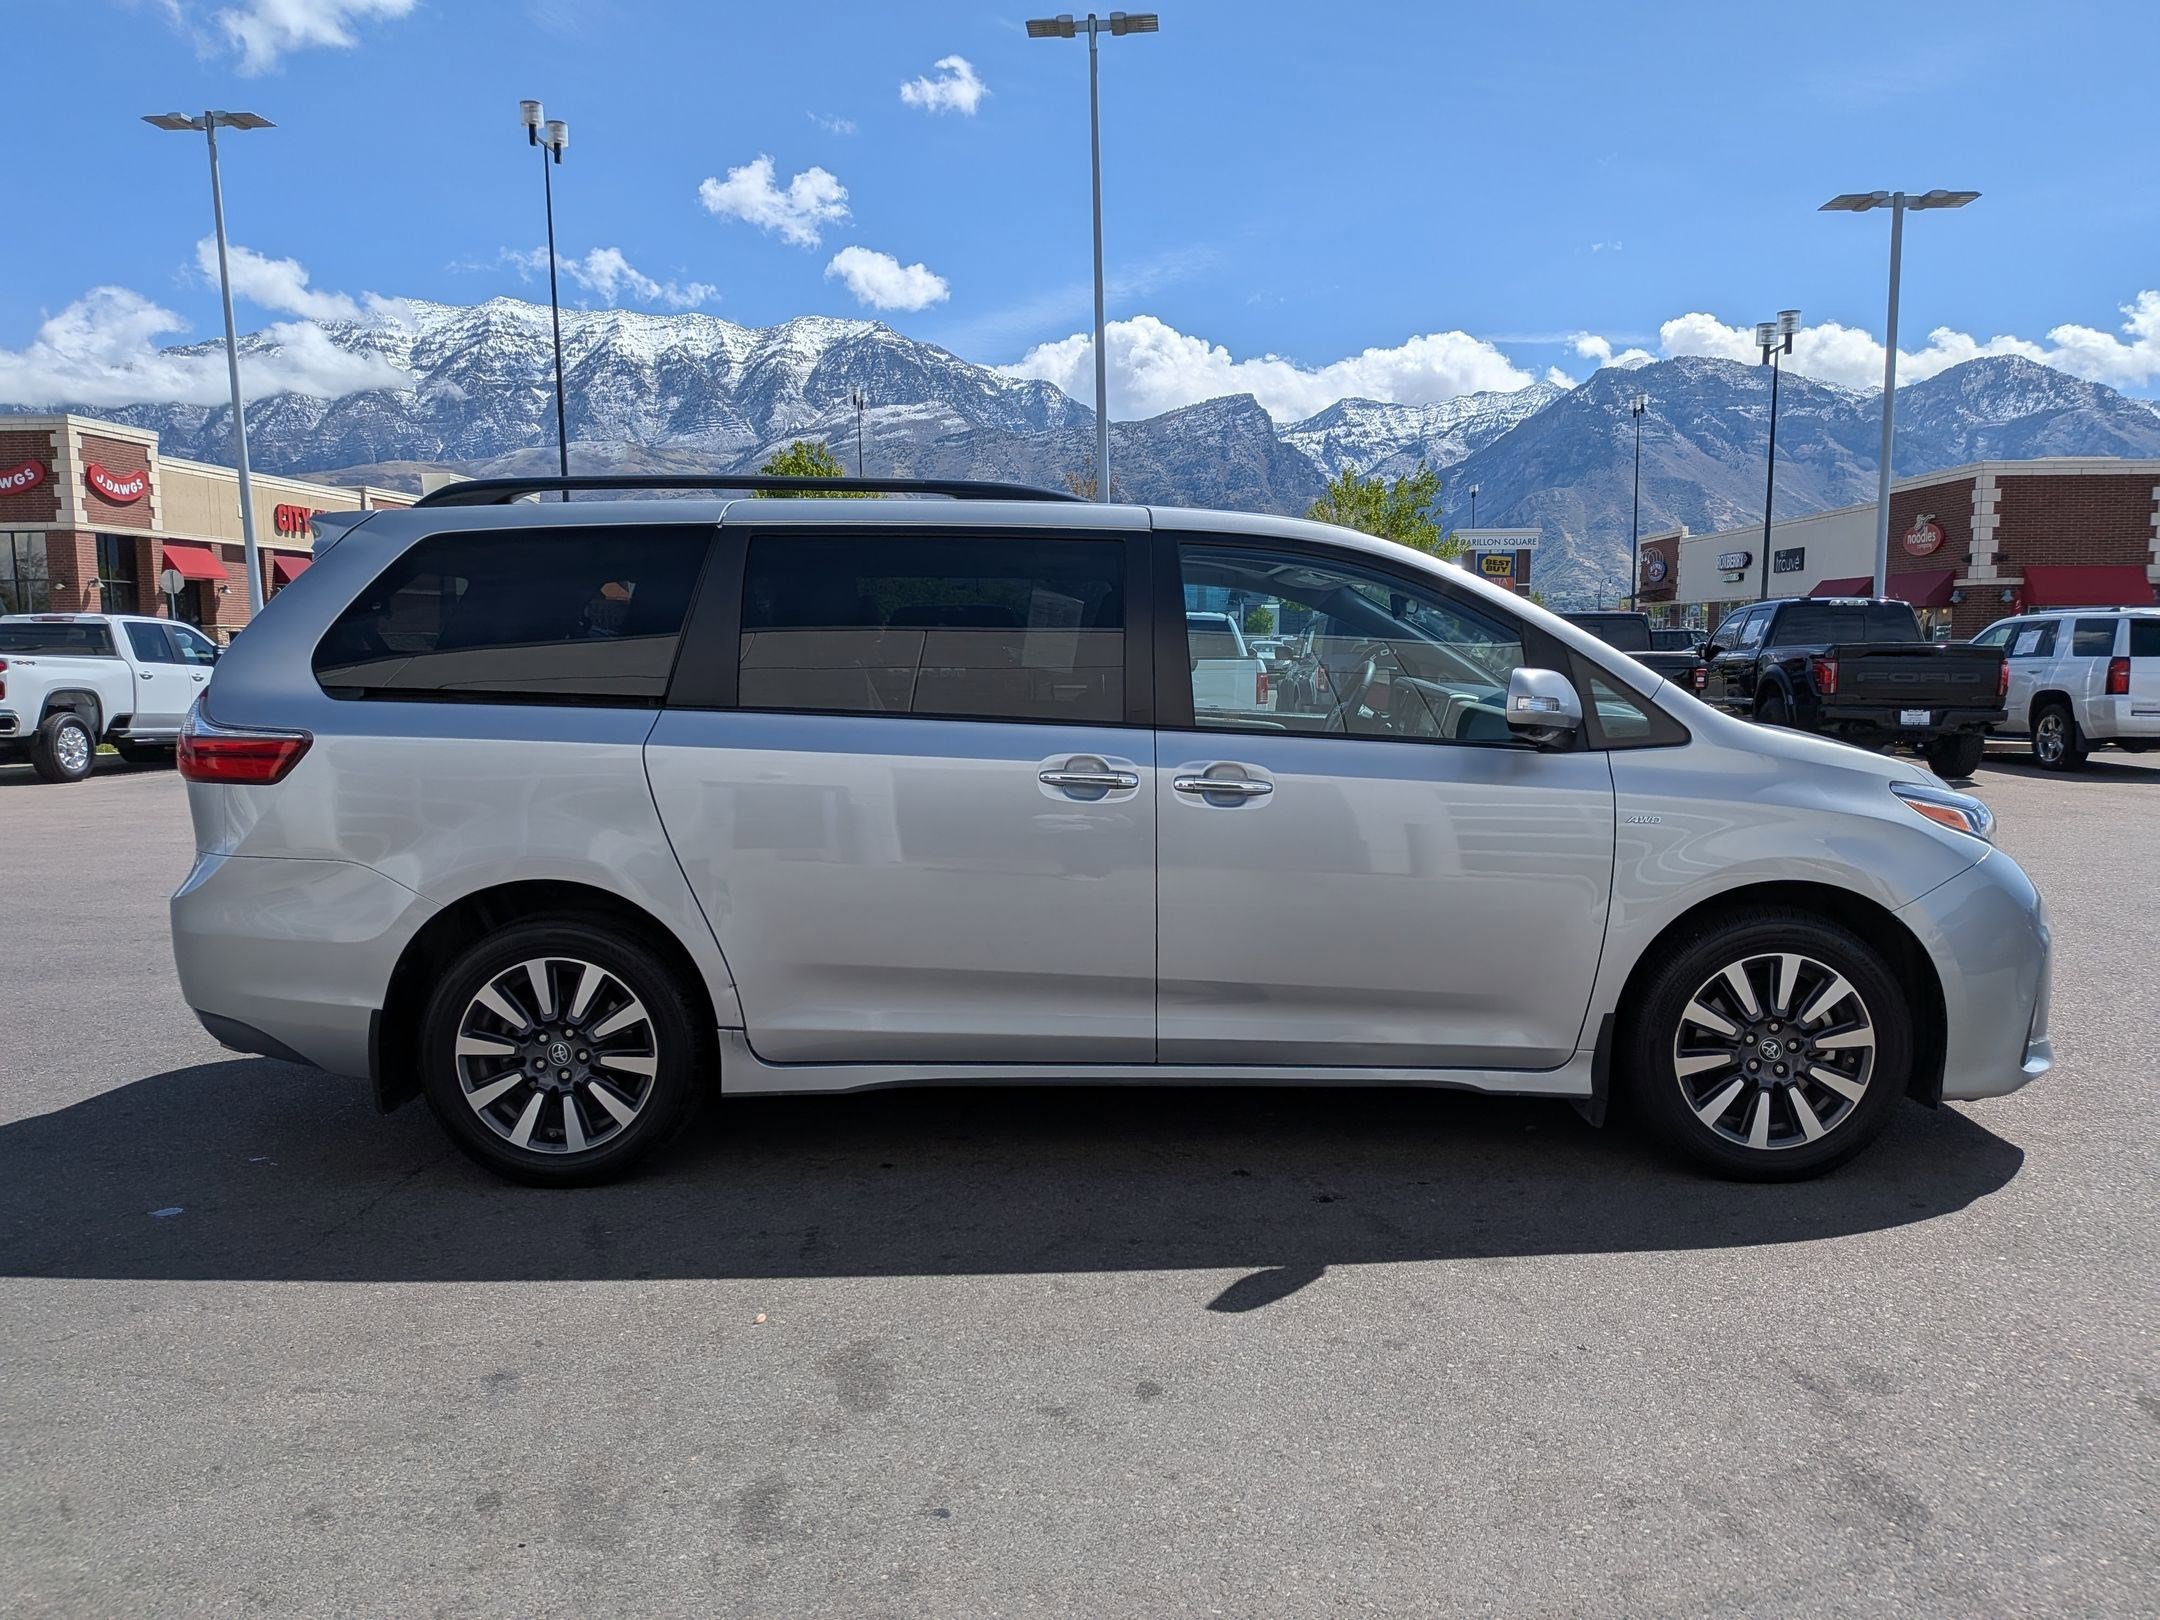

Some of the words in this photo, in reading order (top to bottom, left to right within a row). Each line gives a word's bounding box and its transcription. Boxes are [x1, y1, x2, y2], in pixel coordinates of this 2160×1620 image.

[96, 474, 143, 495] J.DAWGS
[276, 504, 311, 534] CITY
[1907, 525, 1936, 545] noodles
[1503, 538, 1537, 546] SQUARE
[1486, 565, 1508, 573] BUY
[1856, 671, 1981, 683] FORD
[1625, 815, 1662, 825] AWD
